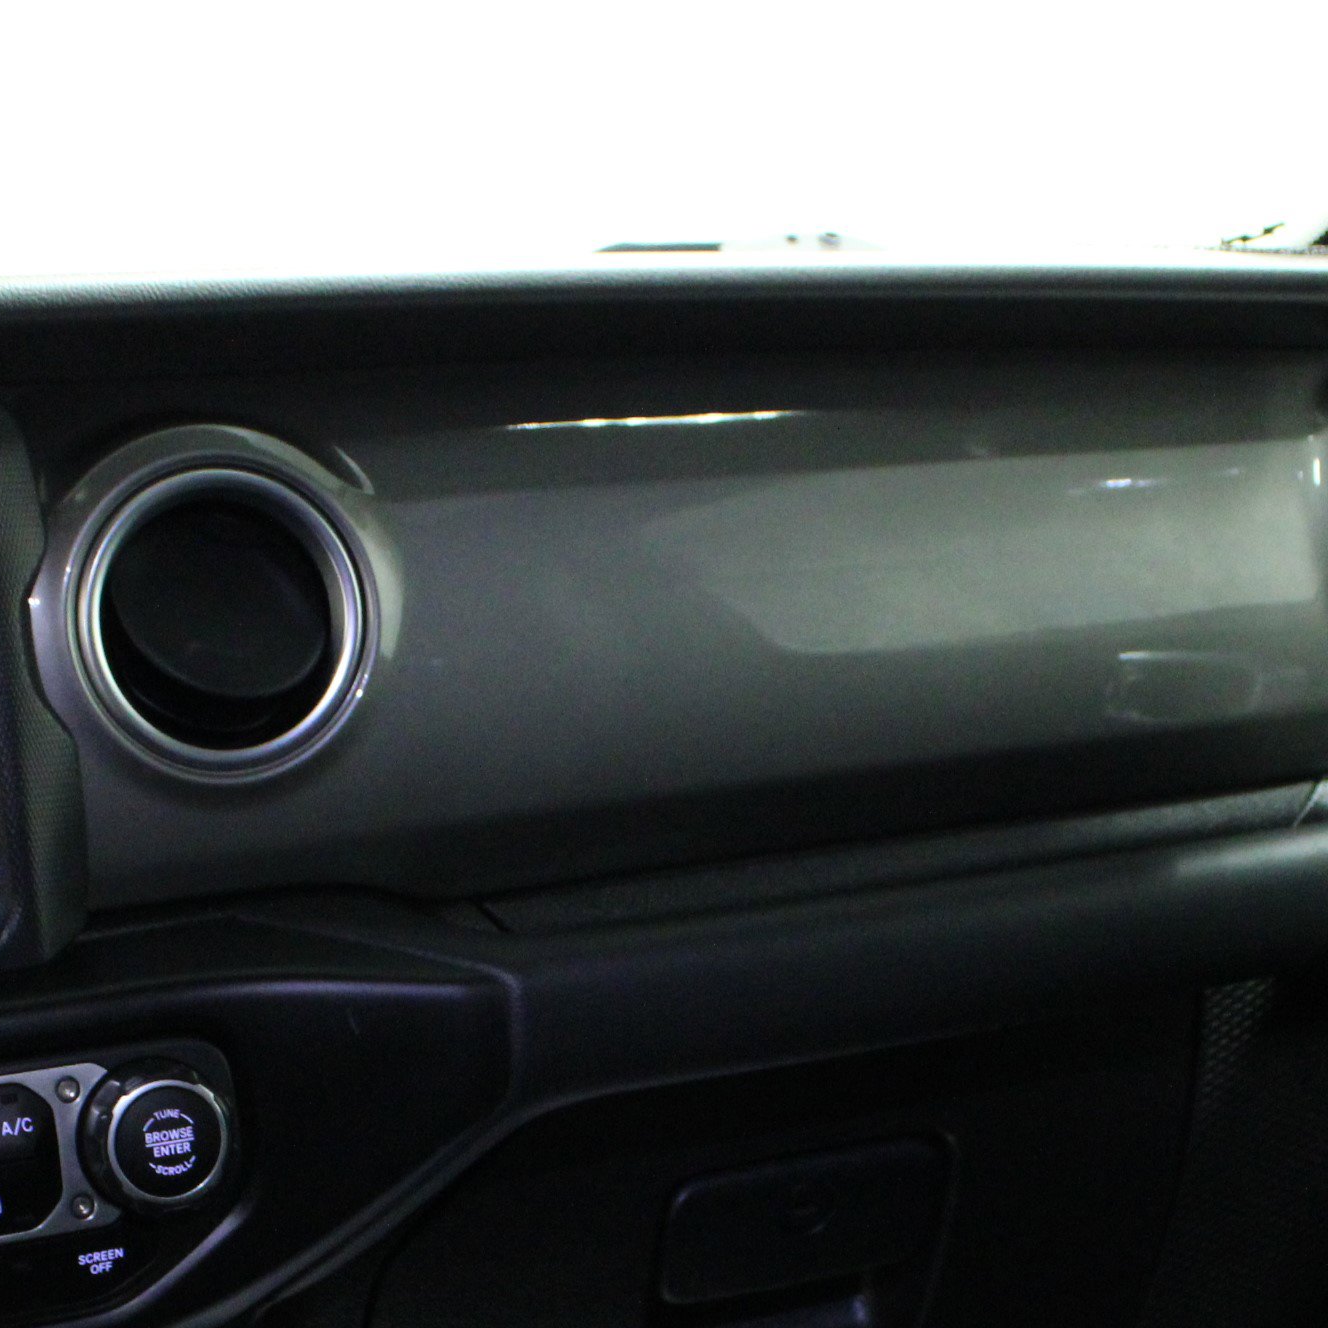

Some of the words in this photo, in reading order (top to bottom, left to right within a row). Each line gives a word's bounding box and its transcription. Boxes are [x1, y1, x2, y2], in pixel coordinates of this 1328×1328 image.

[153, 1108, 180, 1120] TUNE
[1, 1117, 34, 1136] A/C
[145, 1126, 194, 1144] BROWSE
[153, 1142, 191, 1158] ENTER
[155, 1160, 192, 1176] SCROLL
[78, 1247, 124, 1266] SCREEN
[90, 1260, 114, 1275] OFF
